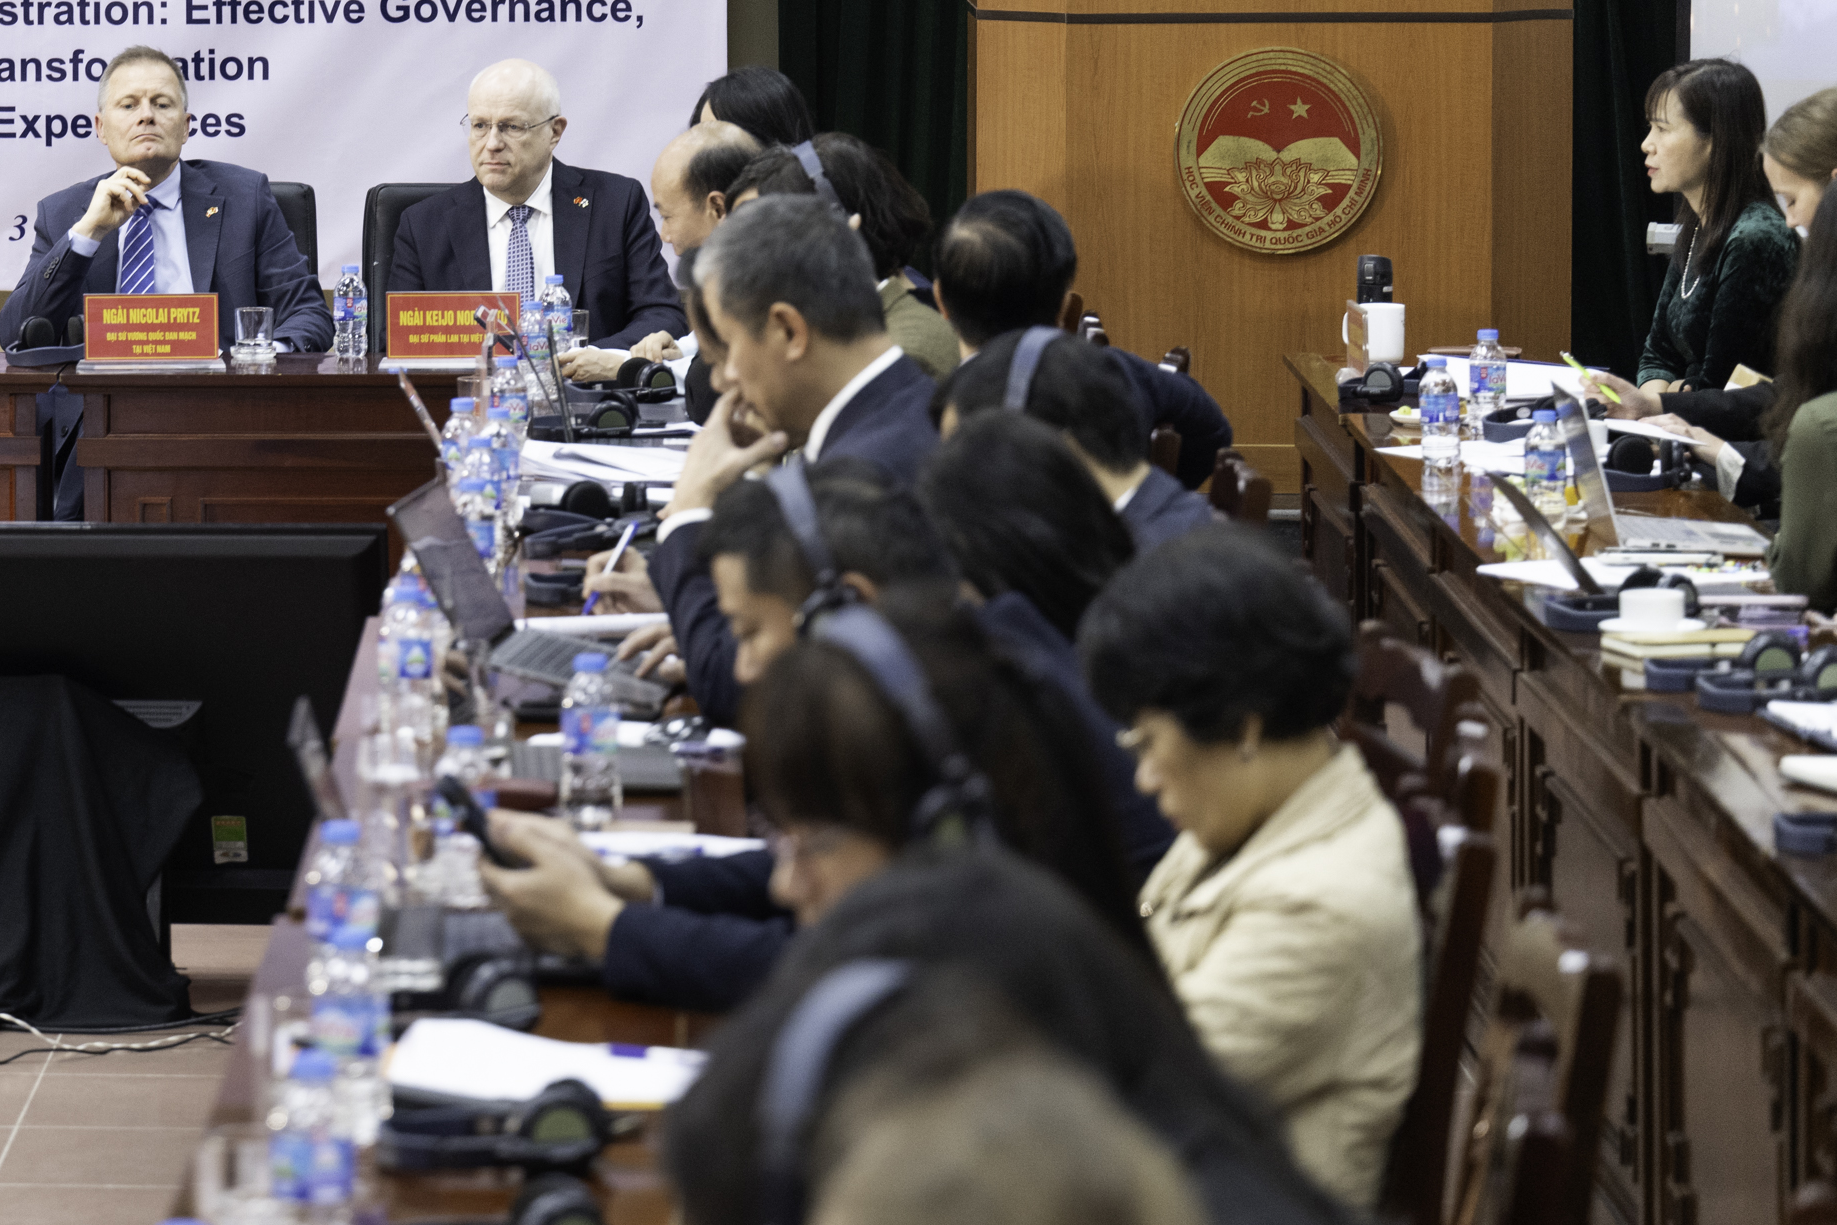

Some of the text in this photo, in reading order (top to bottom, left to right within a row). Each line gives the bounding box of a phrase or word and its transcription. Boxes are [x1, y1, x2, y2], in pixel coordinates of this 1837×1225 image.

[1305, 226, 1326, 241] GIA
[1355, 167, 1373, 200] MINH
[8, 214, 29, 242] 3
[103, 305, 201, 324] NGÀI NICOLAI PRYTZ
[399, 307, 424, 326] NGÀI
[425, 310, 455, 326] KEIJO
